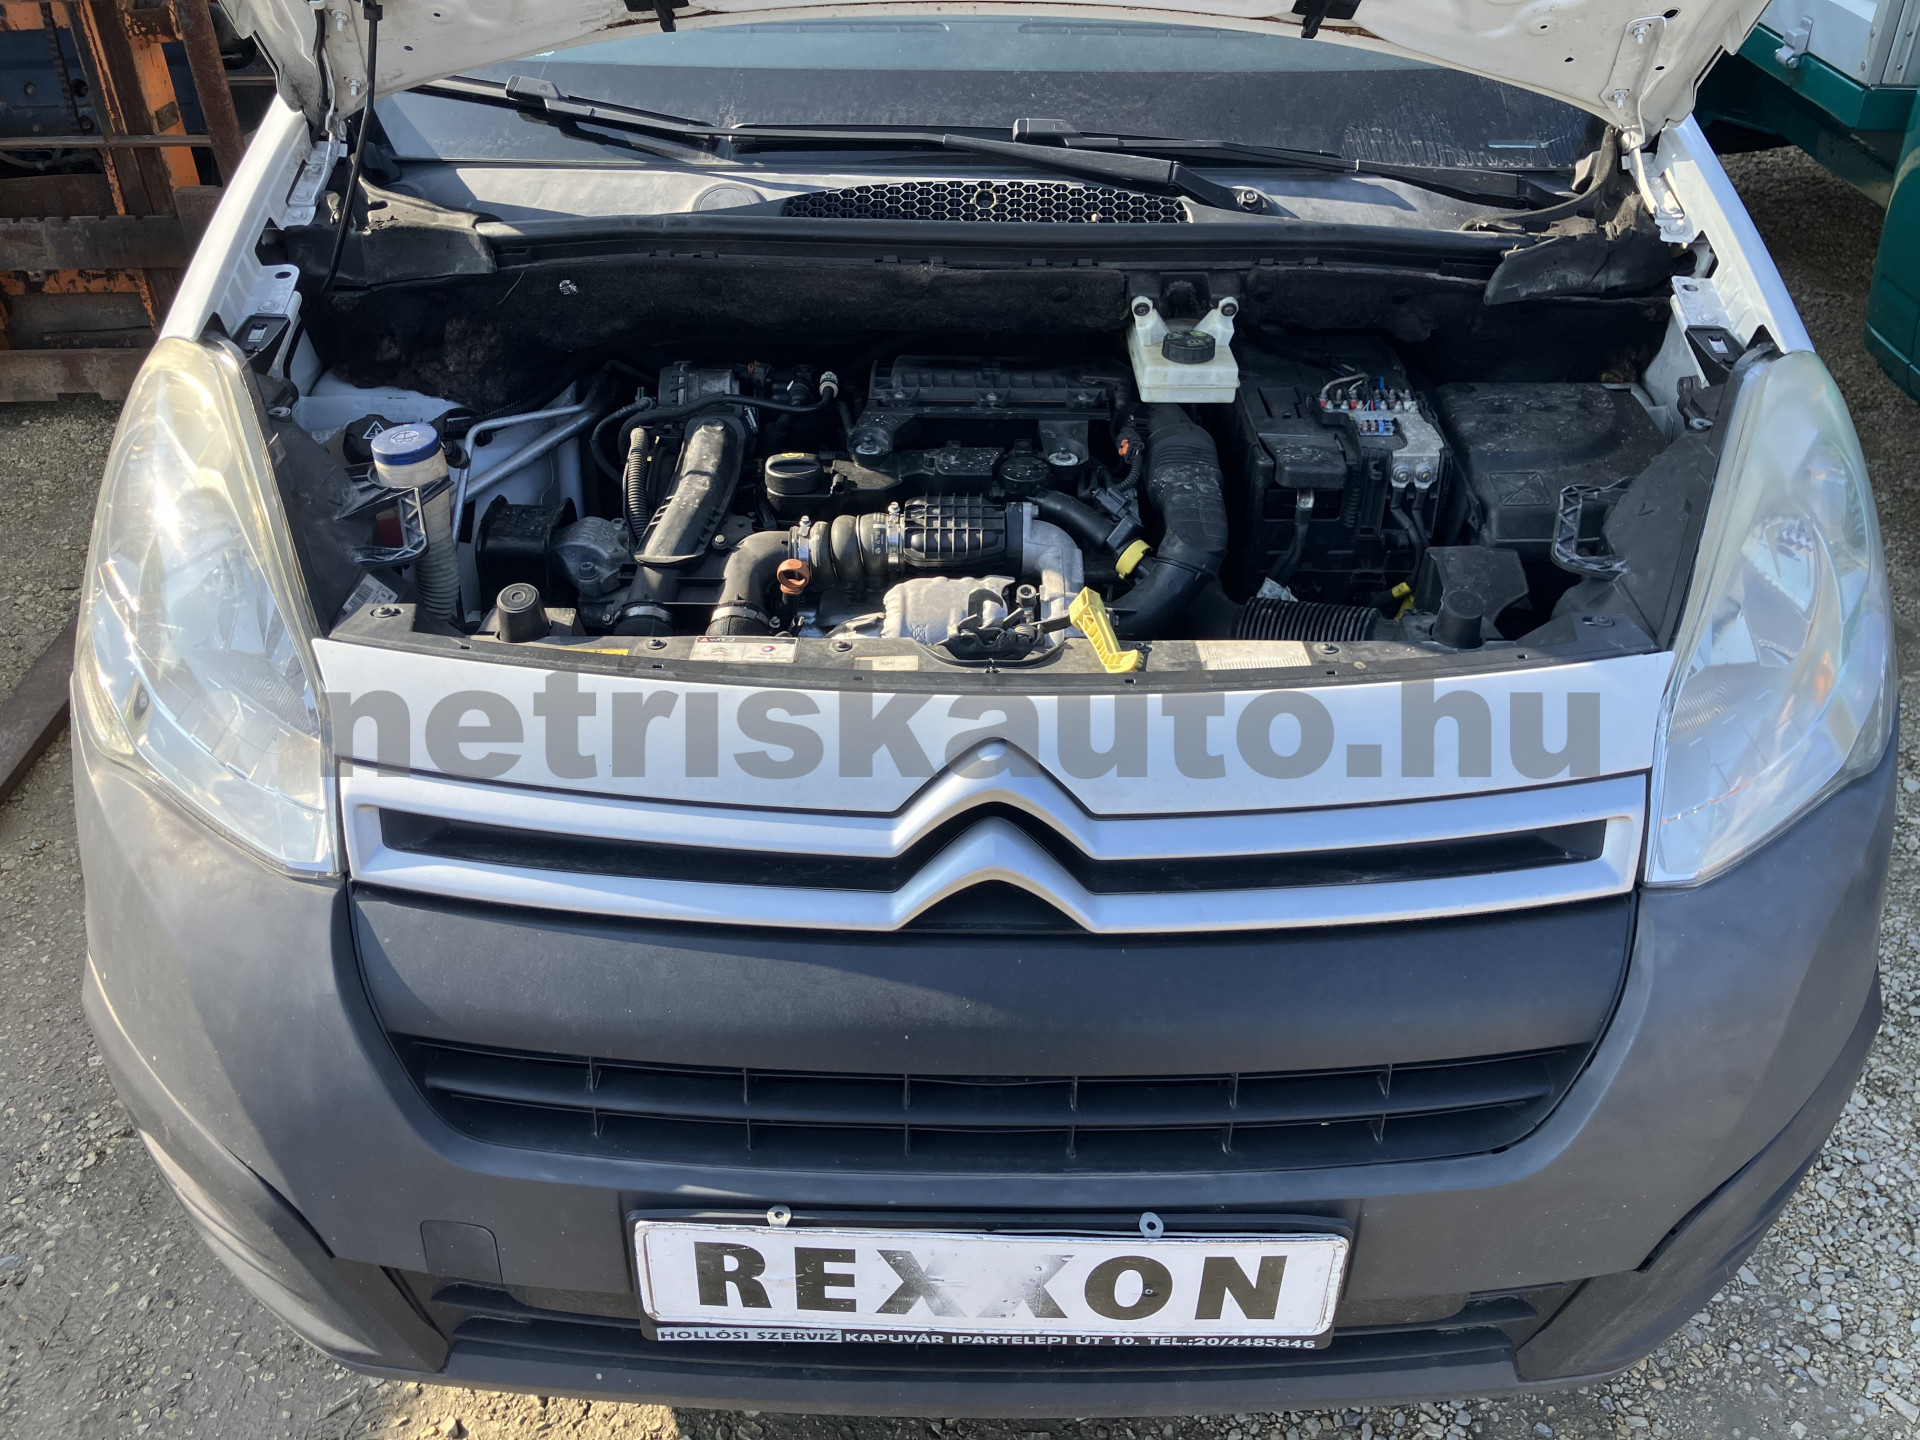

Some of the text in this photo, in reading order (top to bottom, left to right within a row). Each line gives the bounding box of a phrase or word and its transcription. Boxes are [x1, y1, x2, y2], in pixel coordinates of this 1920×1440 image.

[692, 1240, 1290, 1321] REXXON
[660, 1329, 749, 1340] HOLLÓSI
[757, 1331, 838, 1342] SZERVIZ
[845, 1332, 945, 1344] KAPUVÁR
[951, 1335, 1068, 1345] IPARTELEPI
[1075, 1335, 1103, 1346] ÚT
[1111, 1336, 1139, 1346] 10.
